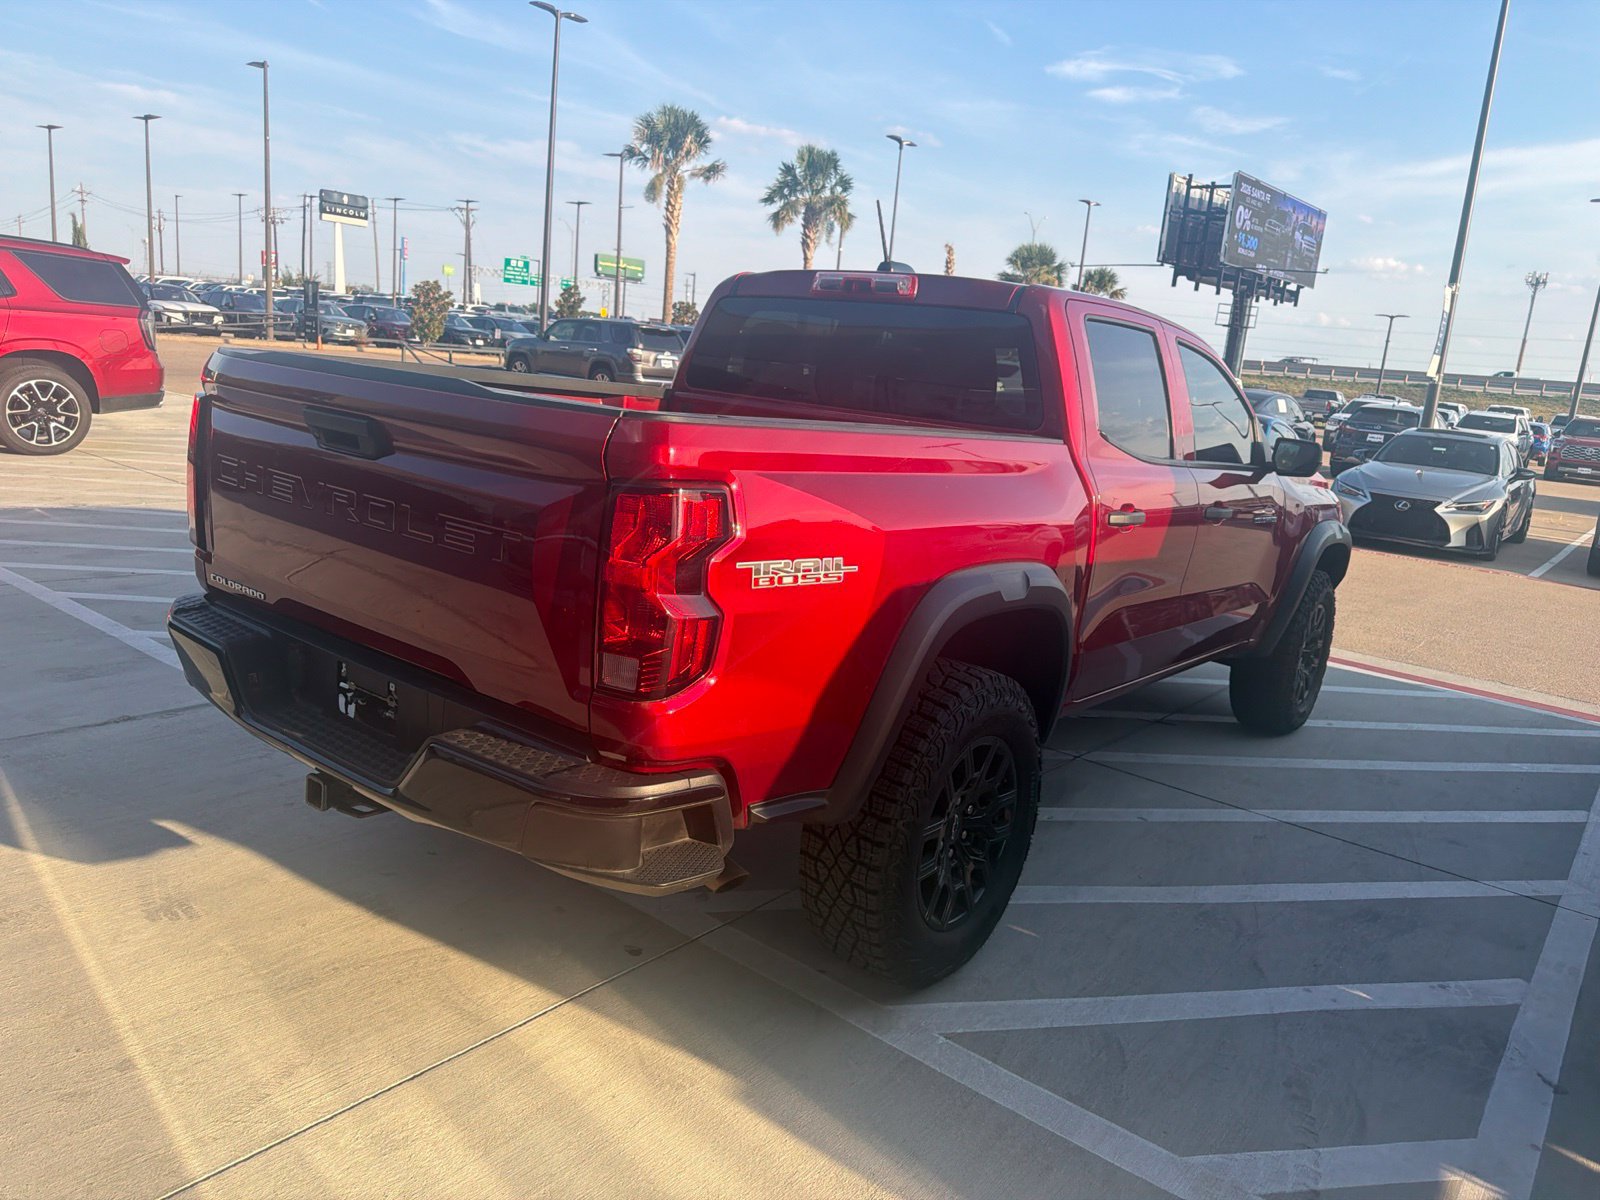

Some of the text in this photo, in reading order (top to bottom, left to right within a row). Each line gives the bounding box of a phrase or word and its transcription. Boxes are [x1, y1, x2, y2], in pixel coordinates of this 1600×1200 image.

[325, 205, 366, 218] LINCOLN
[1235, 204, 1252, 231] 0%
[216, 453, 524, 563] CHEVROLET
[736, 557, 858, 577] TRAIL
[210, 573, 265, 600] COLORADO
[751, 571, 844, 589] BOSS
